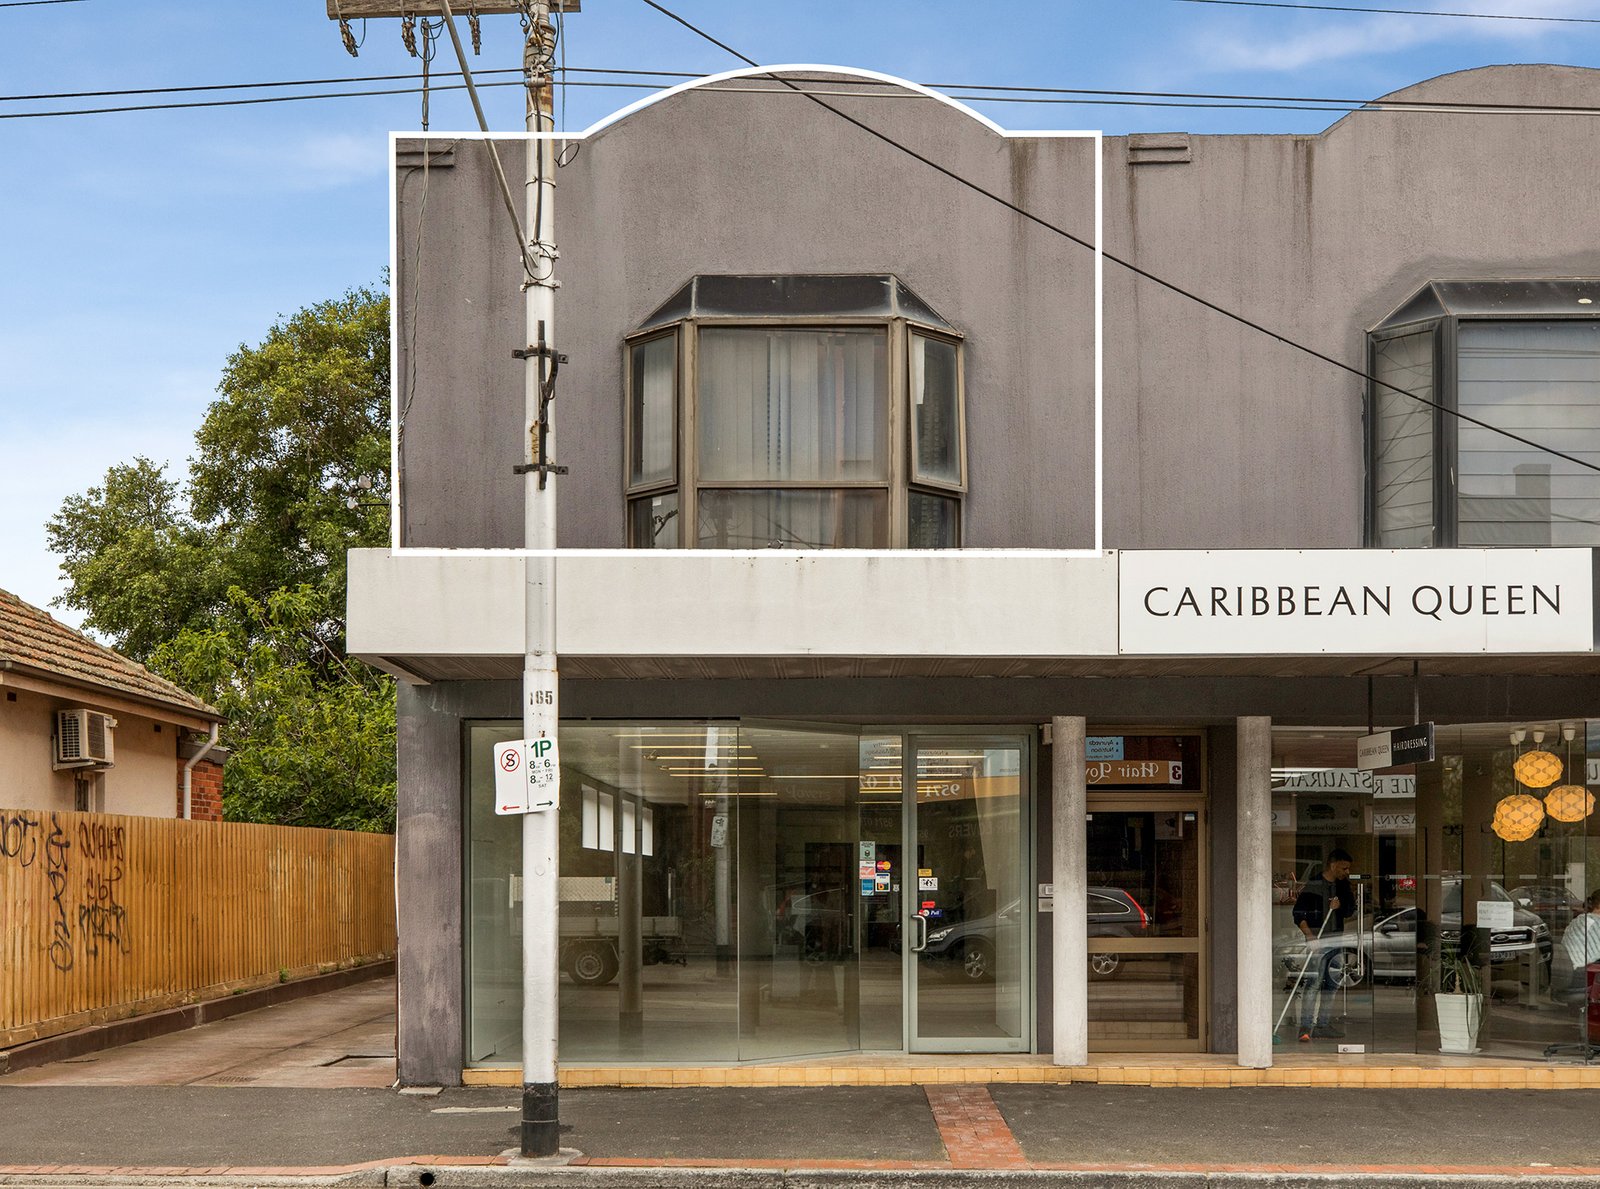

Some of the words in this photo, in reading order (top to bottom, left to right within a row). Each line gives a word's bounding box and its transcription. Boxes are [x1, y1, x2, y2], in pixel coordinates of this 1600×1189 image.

[1143, 585, 1392, 617] CARIBBEAN
[1411, 584, 1562, 621] QUEEN
[529, 690, 553, 705] 165
[530, 740, 552, 758] 1P
[1392, 736, 1428, 752] HAIRDRESSING
